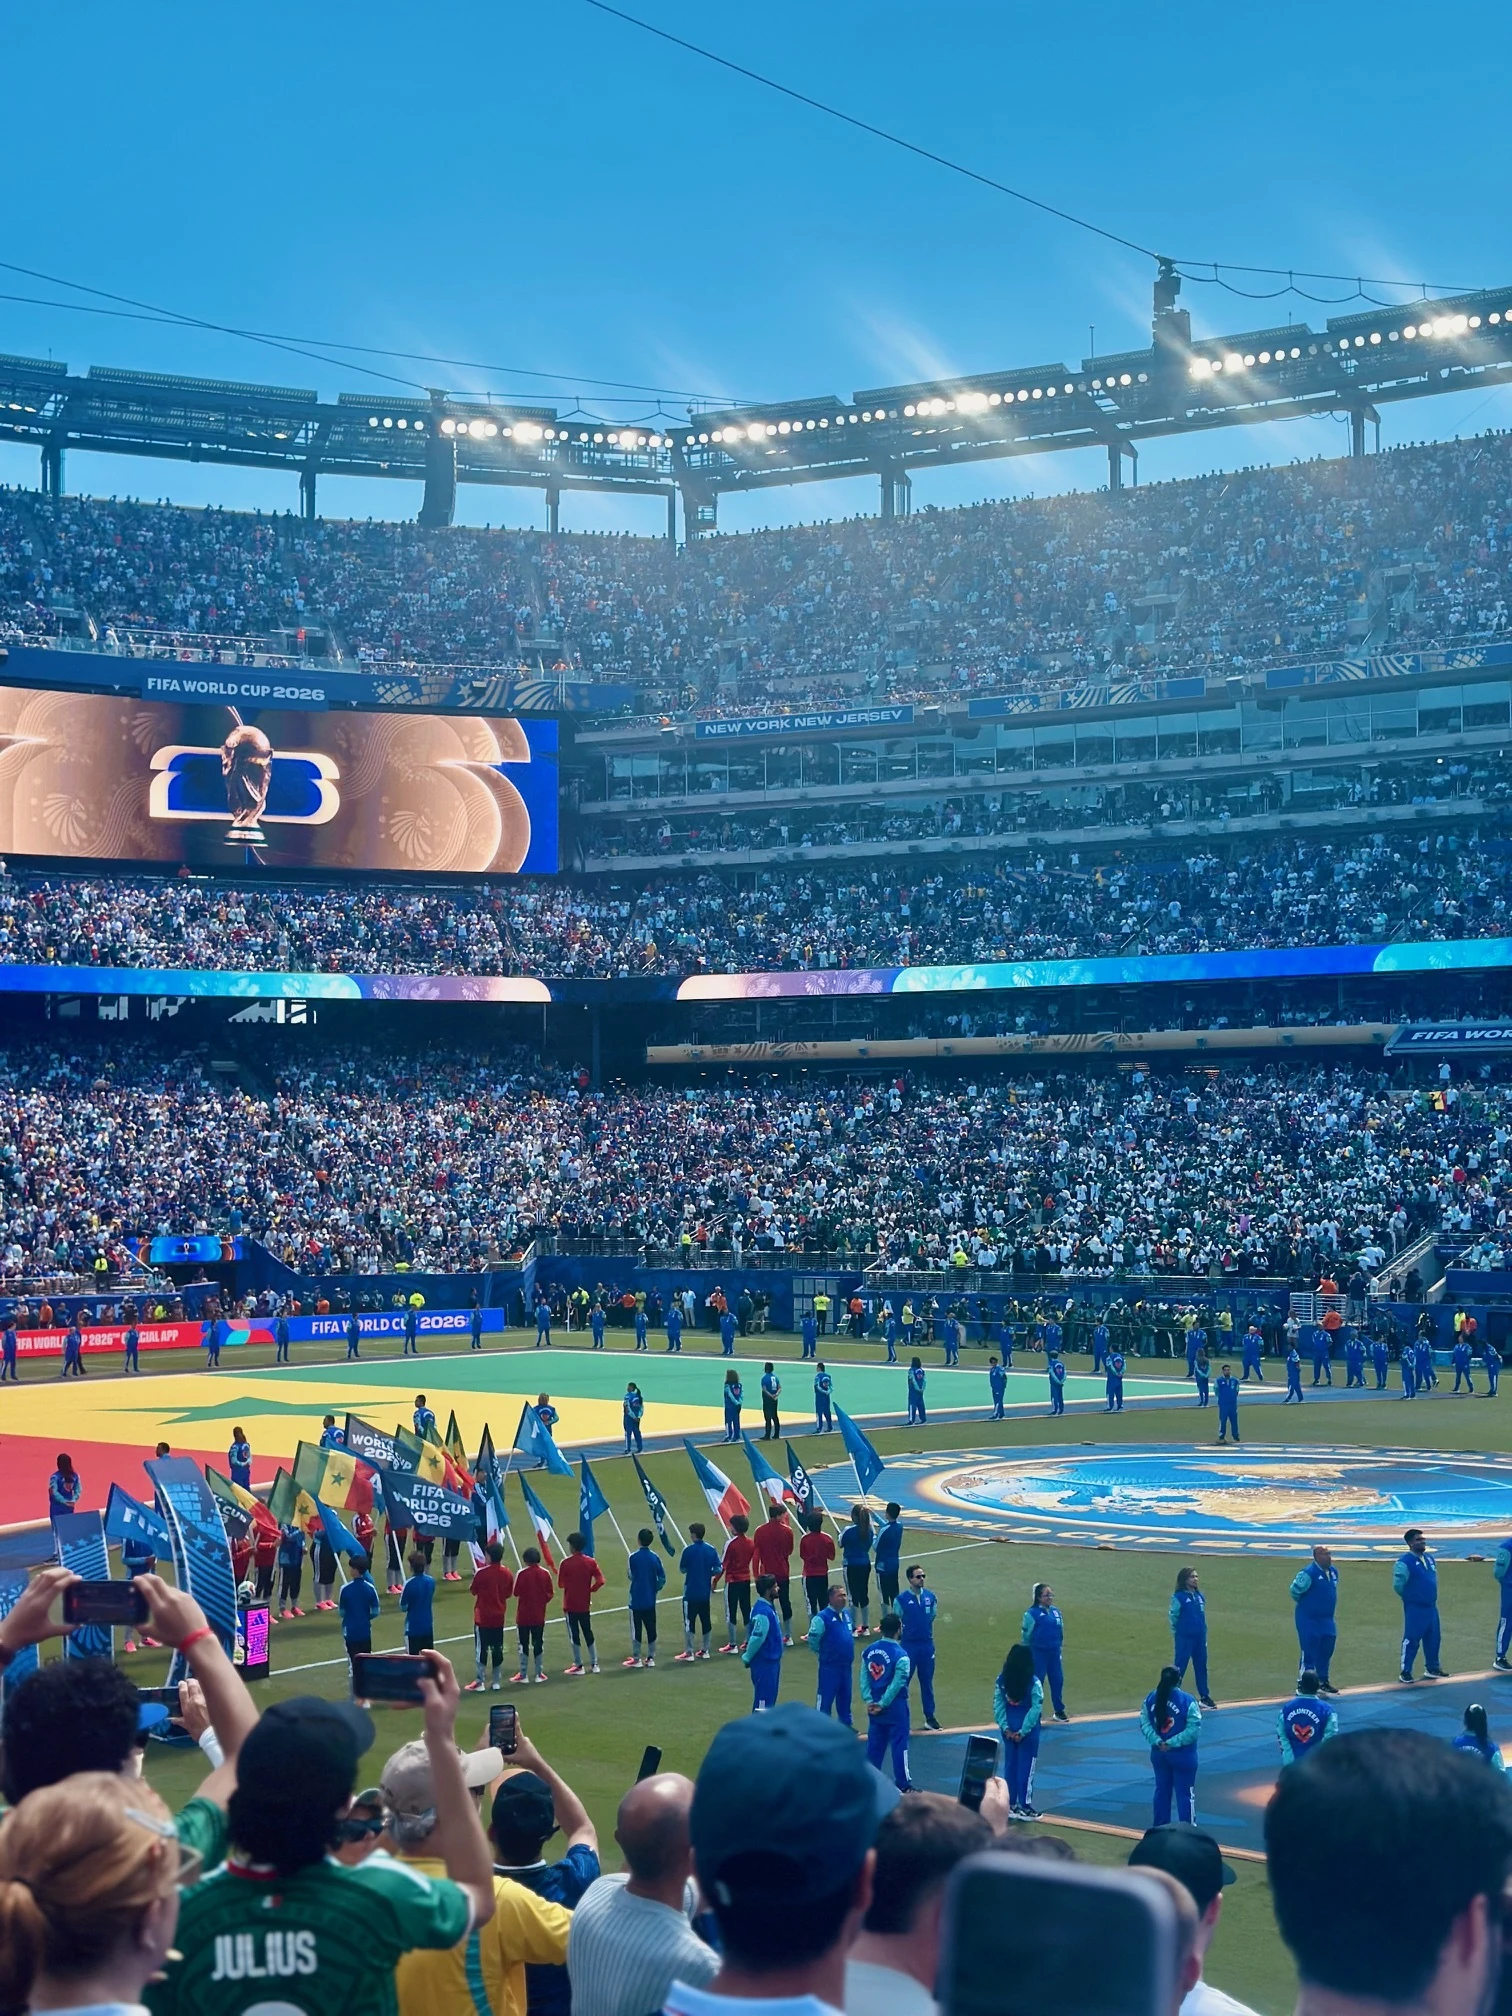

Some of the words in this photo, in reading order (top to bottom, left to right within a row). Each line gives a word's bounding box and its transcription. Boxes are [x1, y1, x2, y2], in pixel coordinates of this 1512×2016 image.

[147, 677, 181, 692] FIFA
[182, 680, 238, 695] WORLD
[240, 685, 271, 697] CUP
[272, 686, 326, 702] 2026
[704, 722, 742, 735] NEW
[744, 718, 791, 731] YORK
[794, 715, 832, 727] NEW
[835, 709, 904, 724] JERSEY
[1410, 1030, 1459, 1041] FIFA
[311, 1320, 341, 1335] FIFA
[160, 1329, 179, 1343] APP
[411, 1483, 445, 1499] FIFA
[221, 1505, 248, 1524] CUP
[440, 1501, 471, 1516] CUP
[410, 1511, 452, 1528] 026
[1056, 1531, 1181, 1544] CUP
[1286, 1707, 1320, 1724] VOLUNTEER
[210, 1930, 318, 1981] JULIUS
